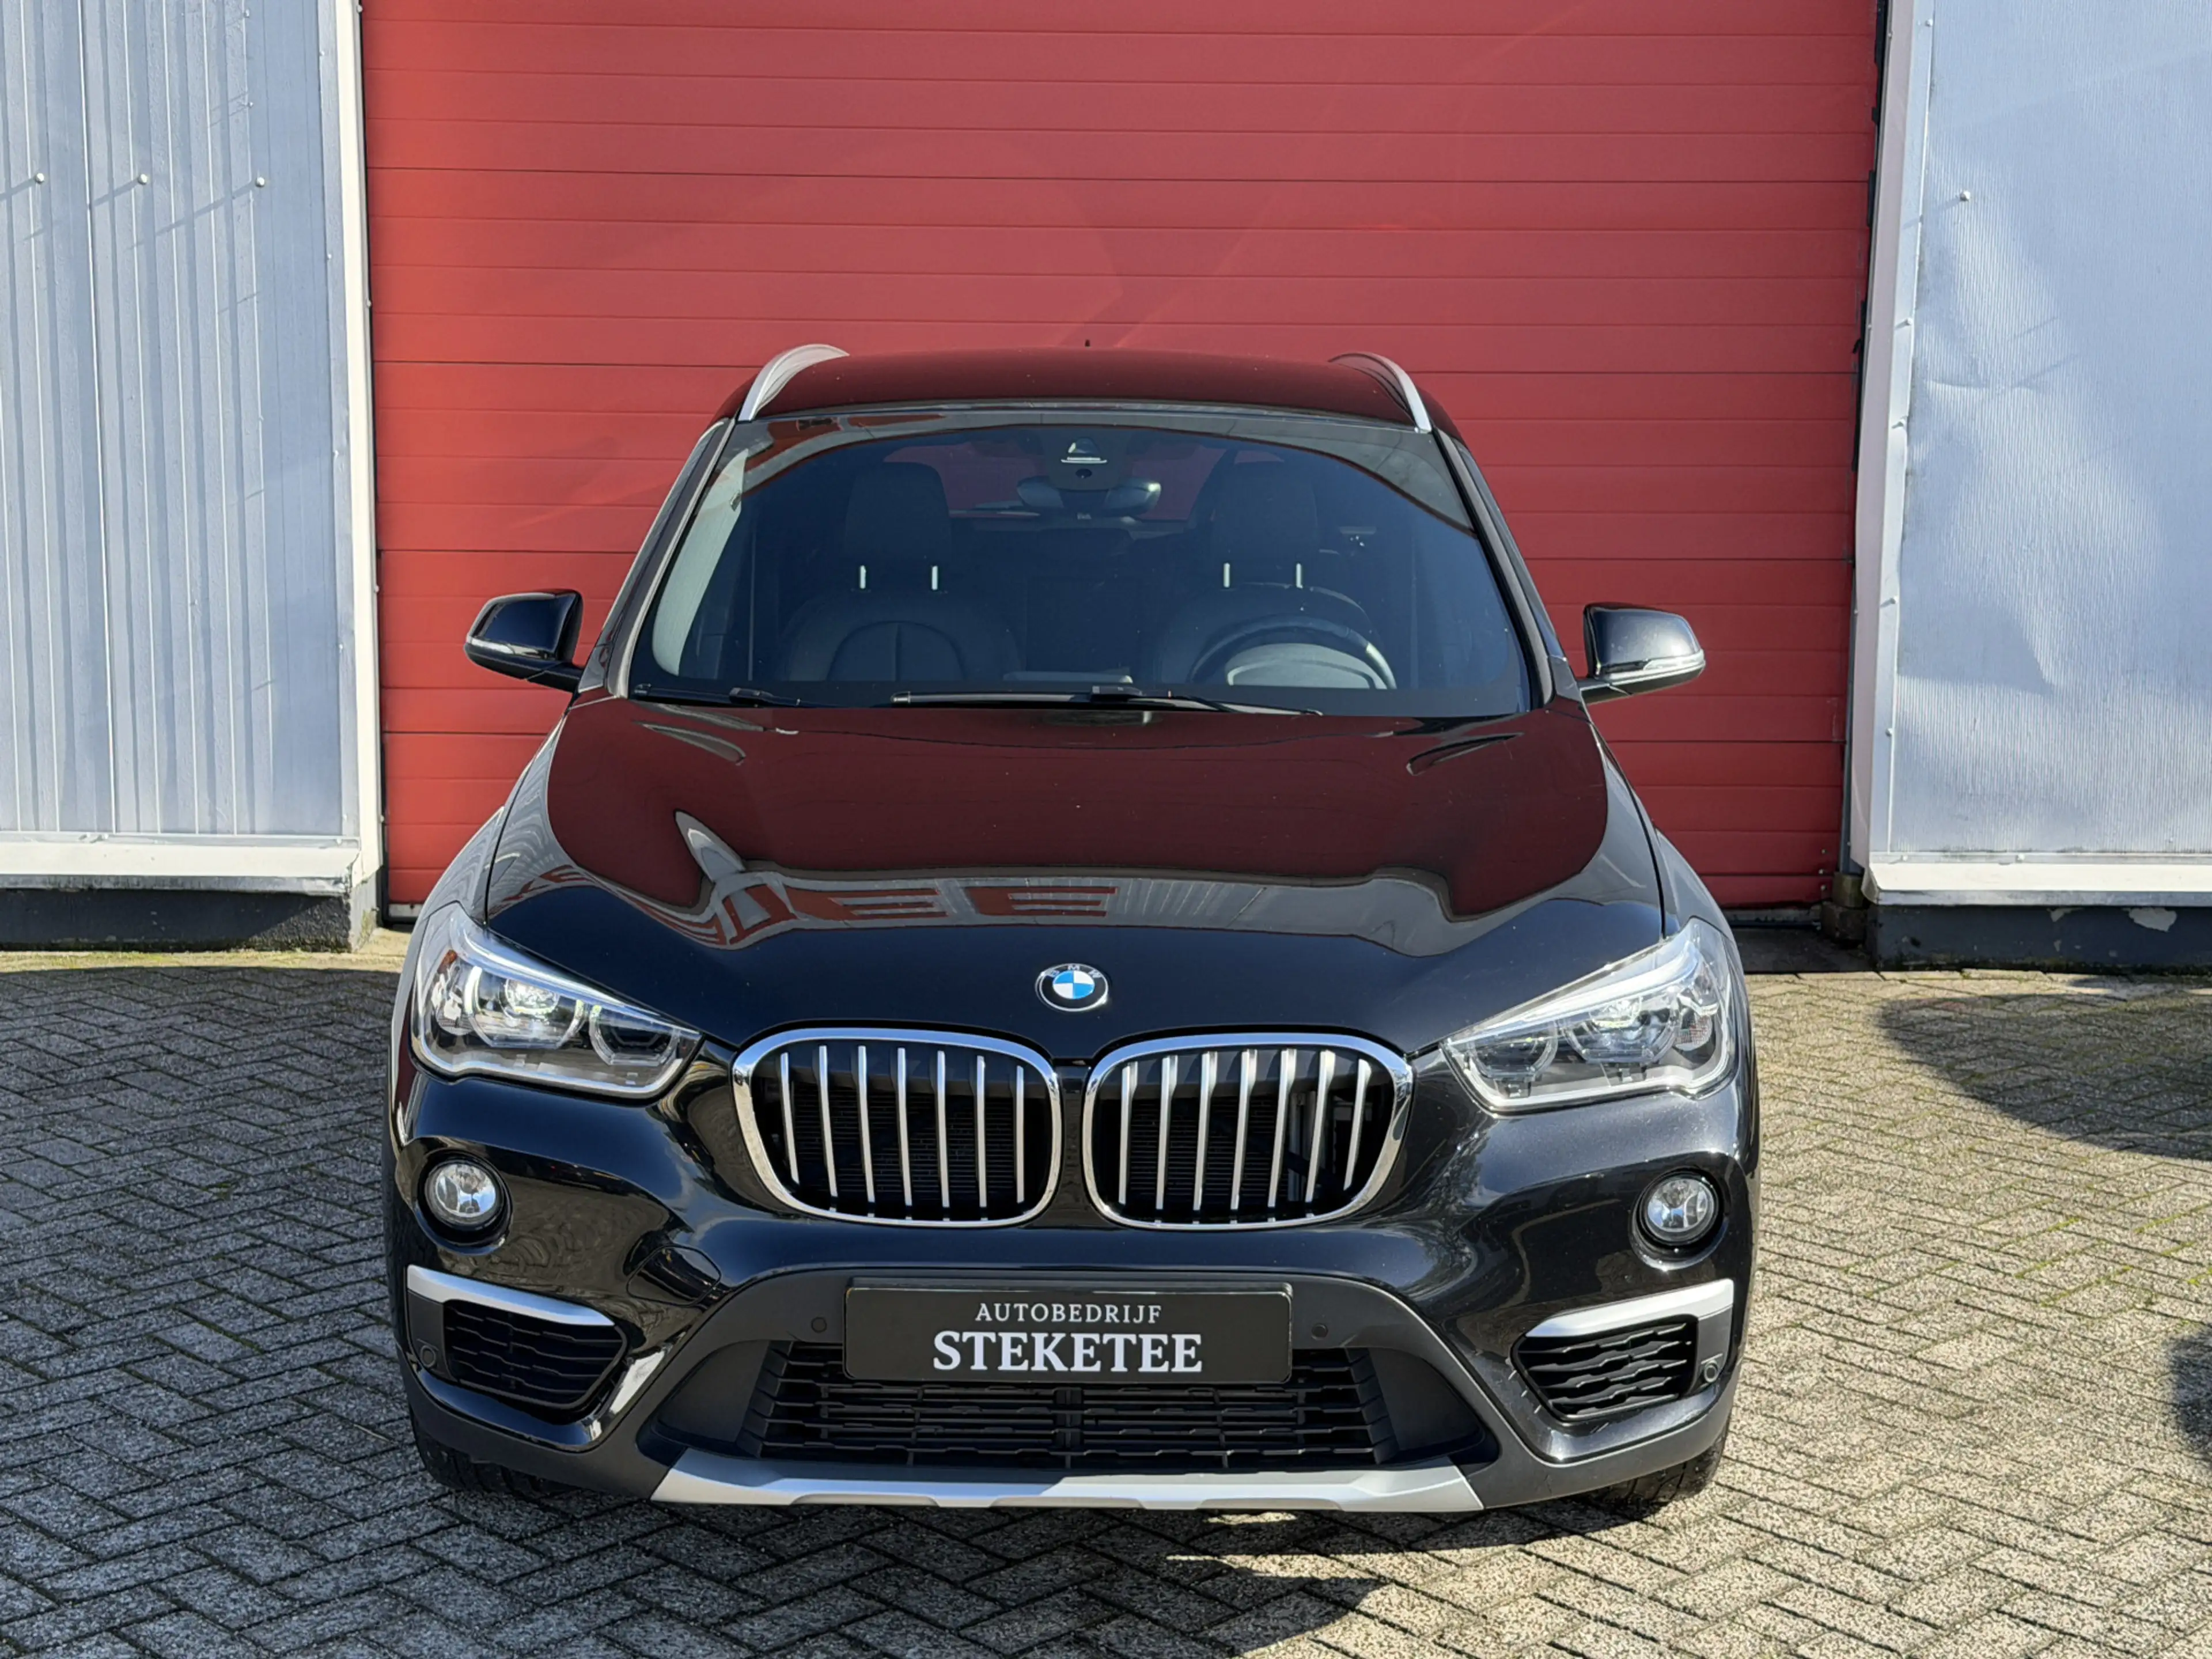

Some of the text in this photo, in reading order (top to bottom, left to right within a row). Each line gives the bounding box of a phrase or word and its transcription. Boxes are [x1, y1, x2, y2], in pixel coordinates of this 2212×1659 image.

[1046, 964, 1102, 978] BMW
[975, 1303, 1162, 1324] AUTOBEDRIJF
[933, 1330, 1202, 1373] STEKETEE
